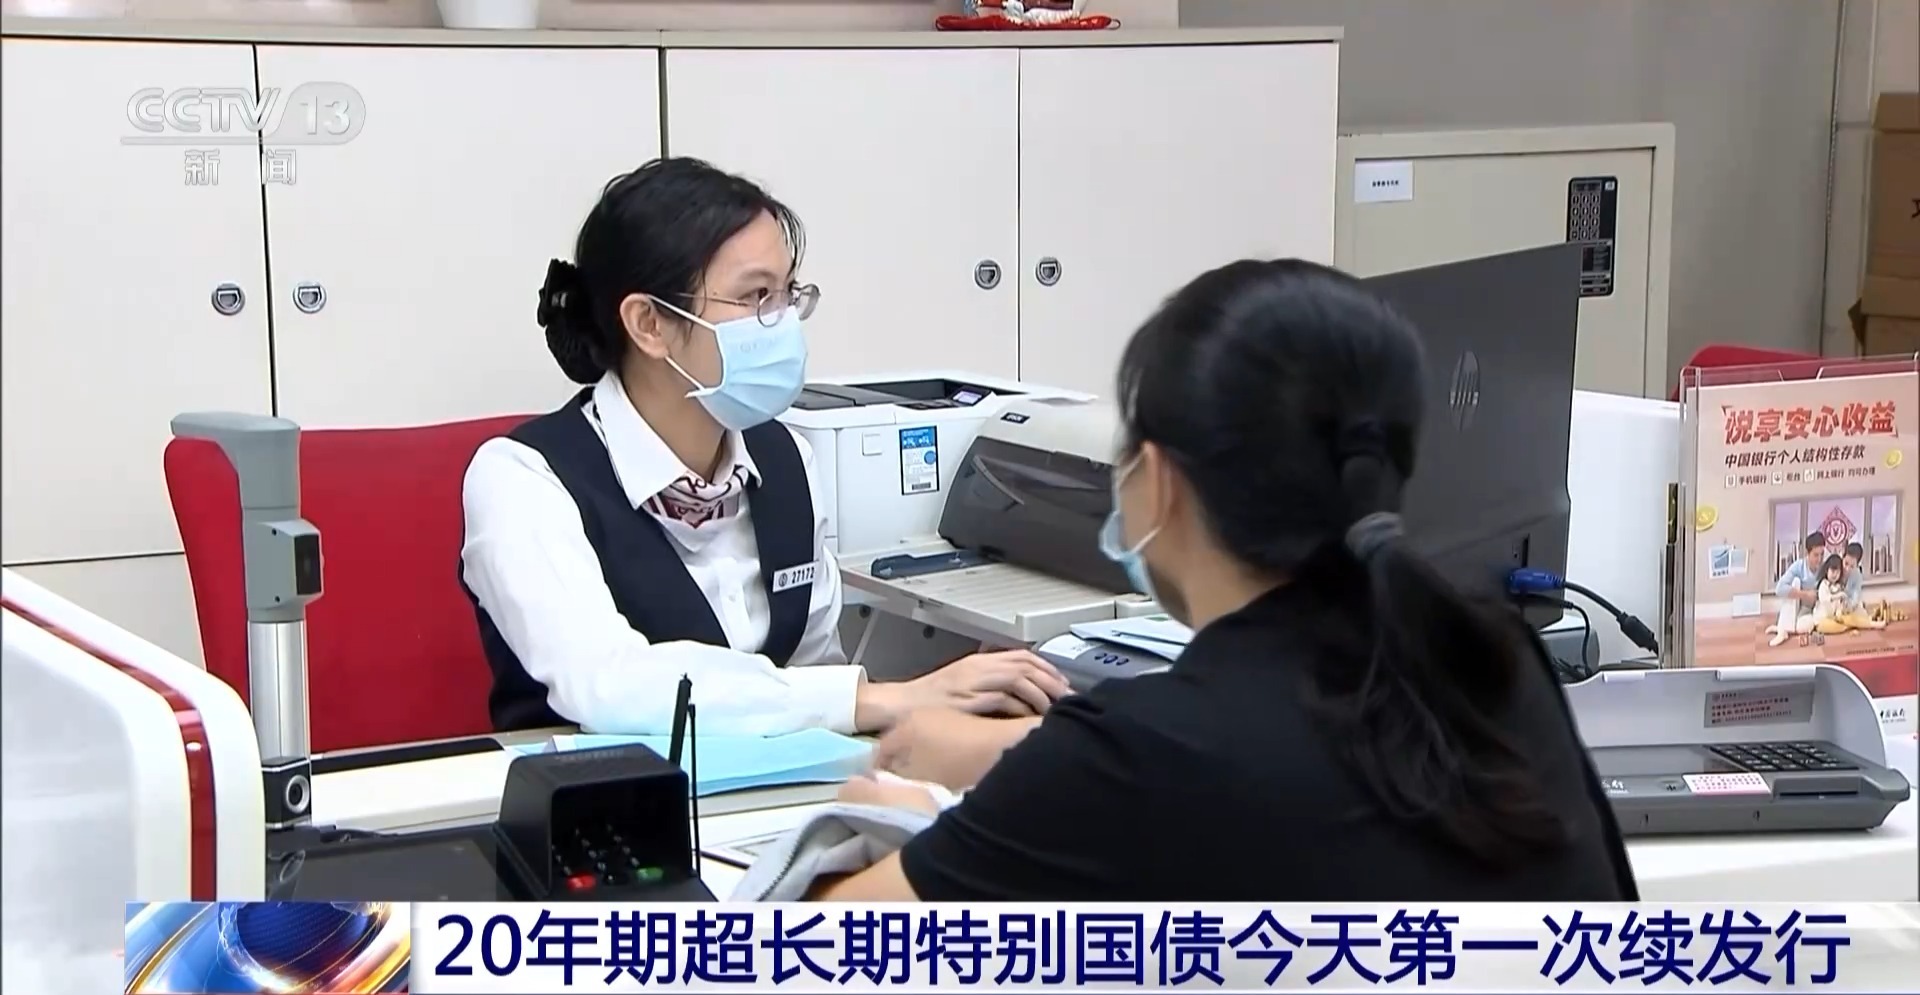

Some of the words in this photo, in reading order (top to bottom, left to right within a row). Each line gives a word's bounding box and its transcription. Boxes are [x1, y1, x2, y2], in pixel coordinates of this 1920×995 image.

[1724, 401, 1896, 445] 悦享安心收益
[1725, 444, 1865, 469] 中国银行个人结构性存款
[792, 567, 814, 583] 27172
